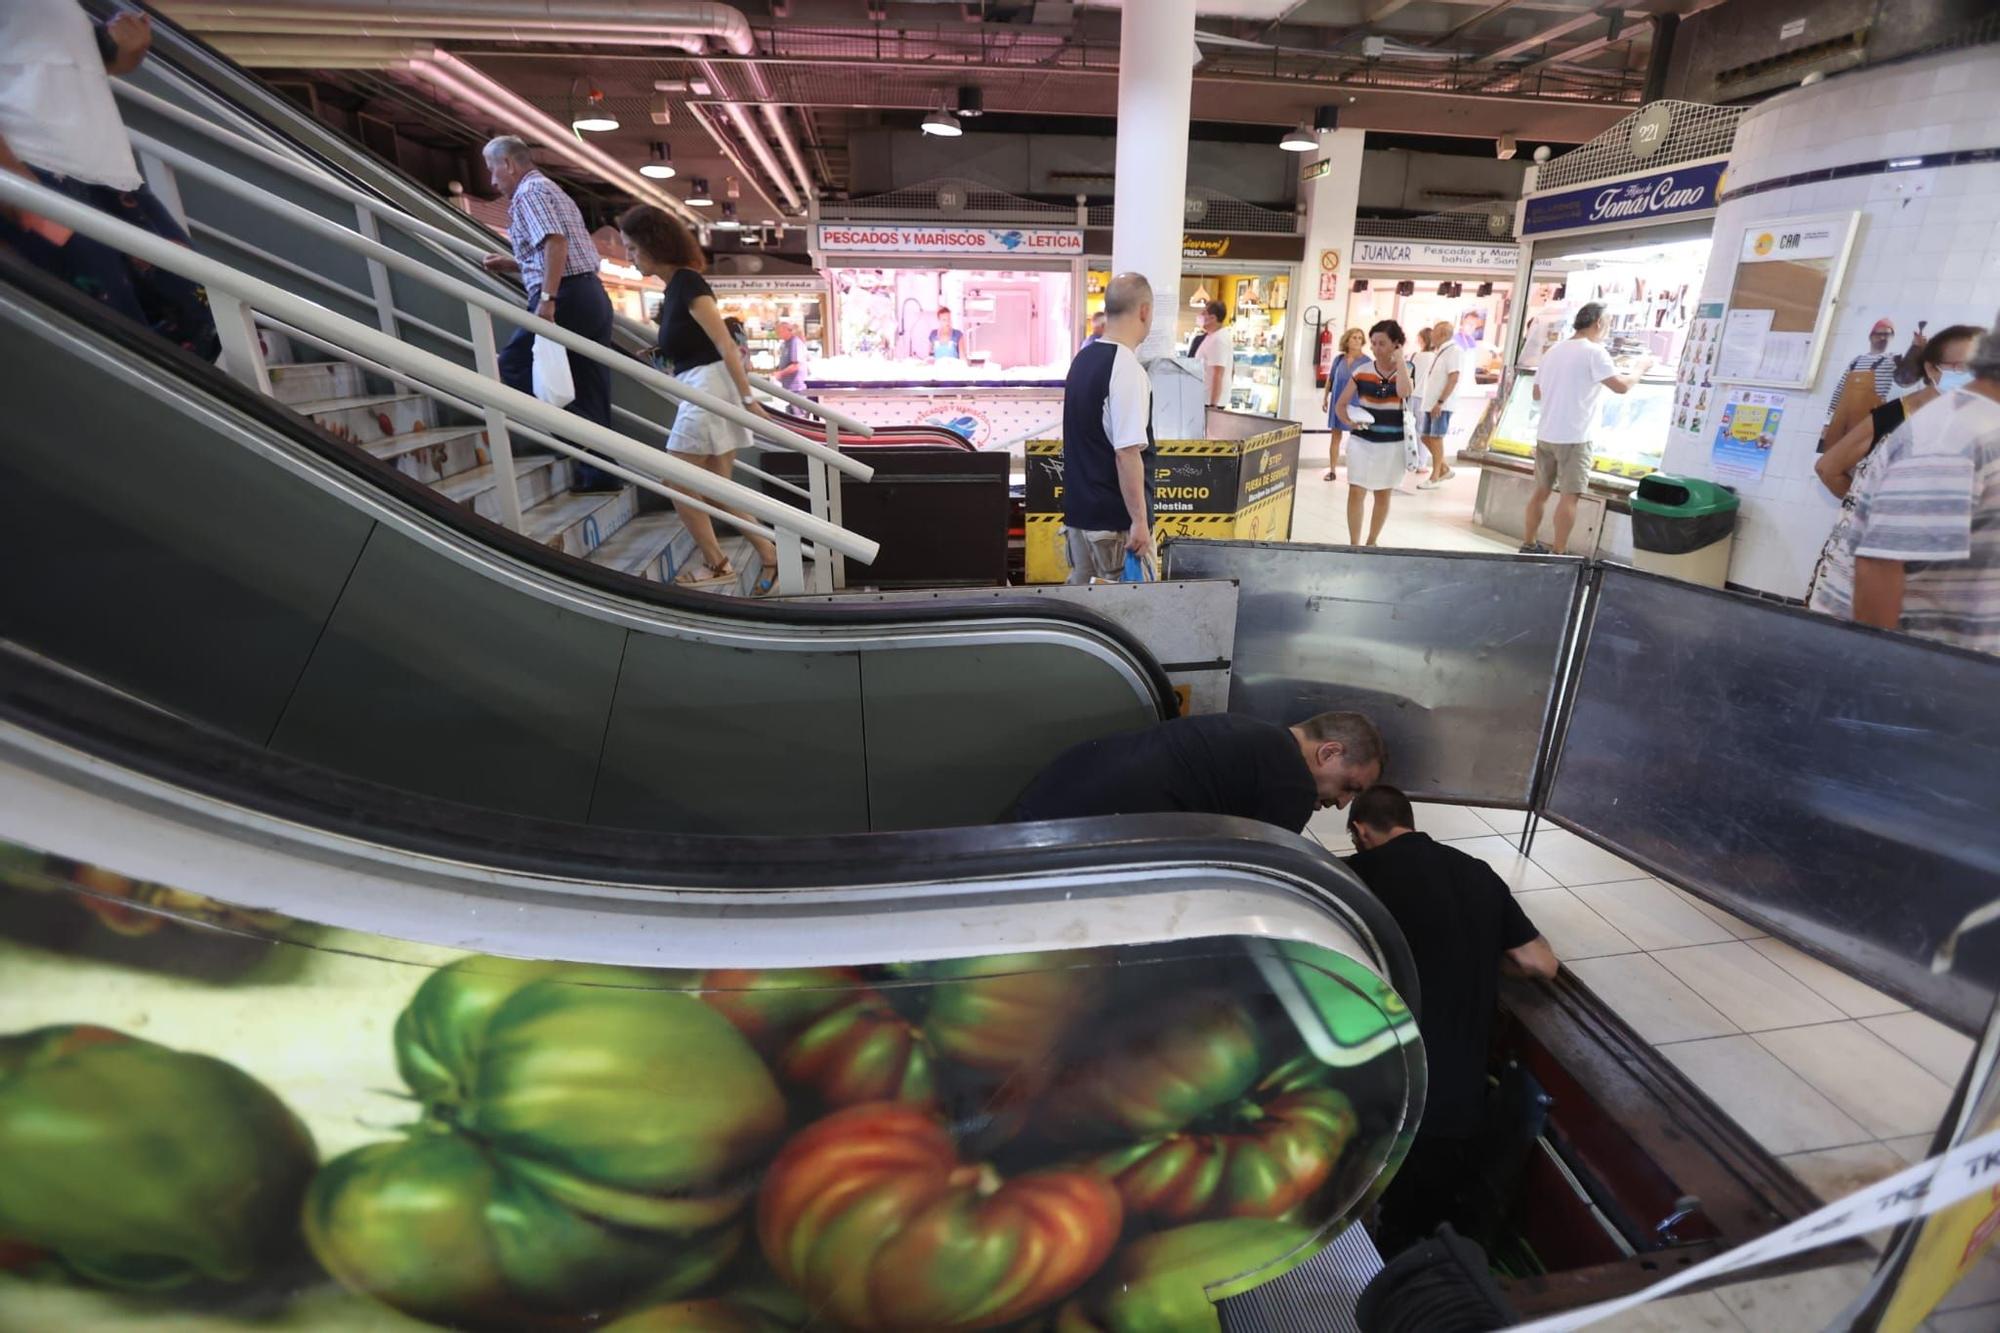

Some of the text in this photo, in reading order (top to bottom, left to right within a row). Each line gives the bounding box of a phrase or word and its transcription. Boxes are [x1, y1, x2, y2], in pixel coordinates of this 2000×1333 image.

[1639, 123, 1660, 143] 221
[1589, 188, 1647, 221] Tomás
[1650, 177, 1705, 211] Cano
[824, 232, 1081, 248] PESCADOS Y MARISCOS LETICIA
[1779, 233, 1801, 249] CAM
[1361, 244, 1411, 261] JUANCAR
[1424, 246, 1476, 256] Pescados
[1476, 256, 1490, 265] de
[1155, 486, 1210, 499] RVICIO
[1153, 502, 1194, 511] olestias
